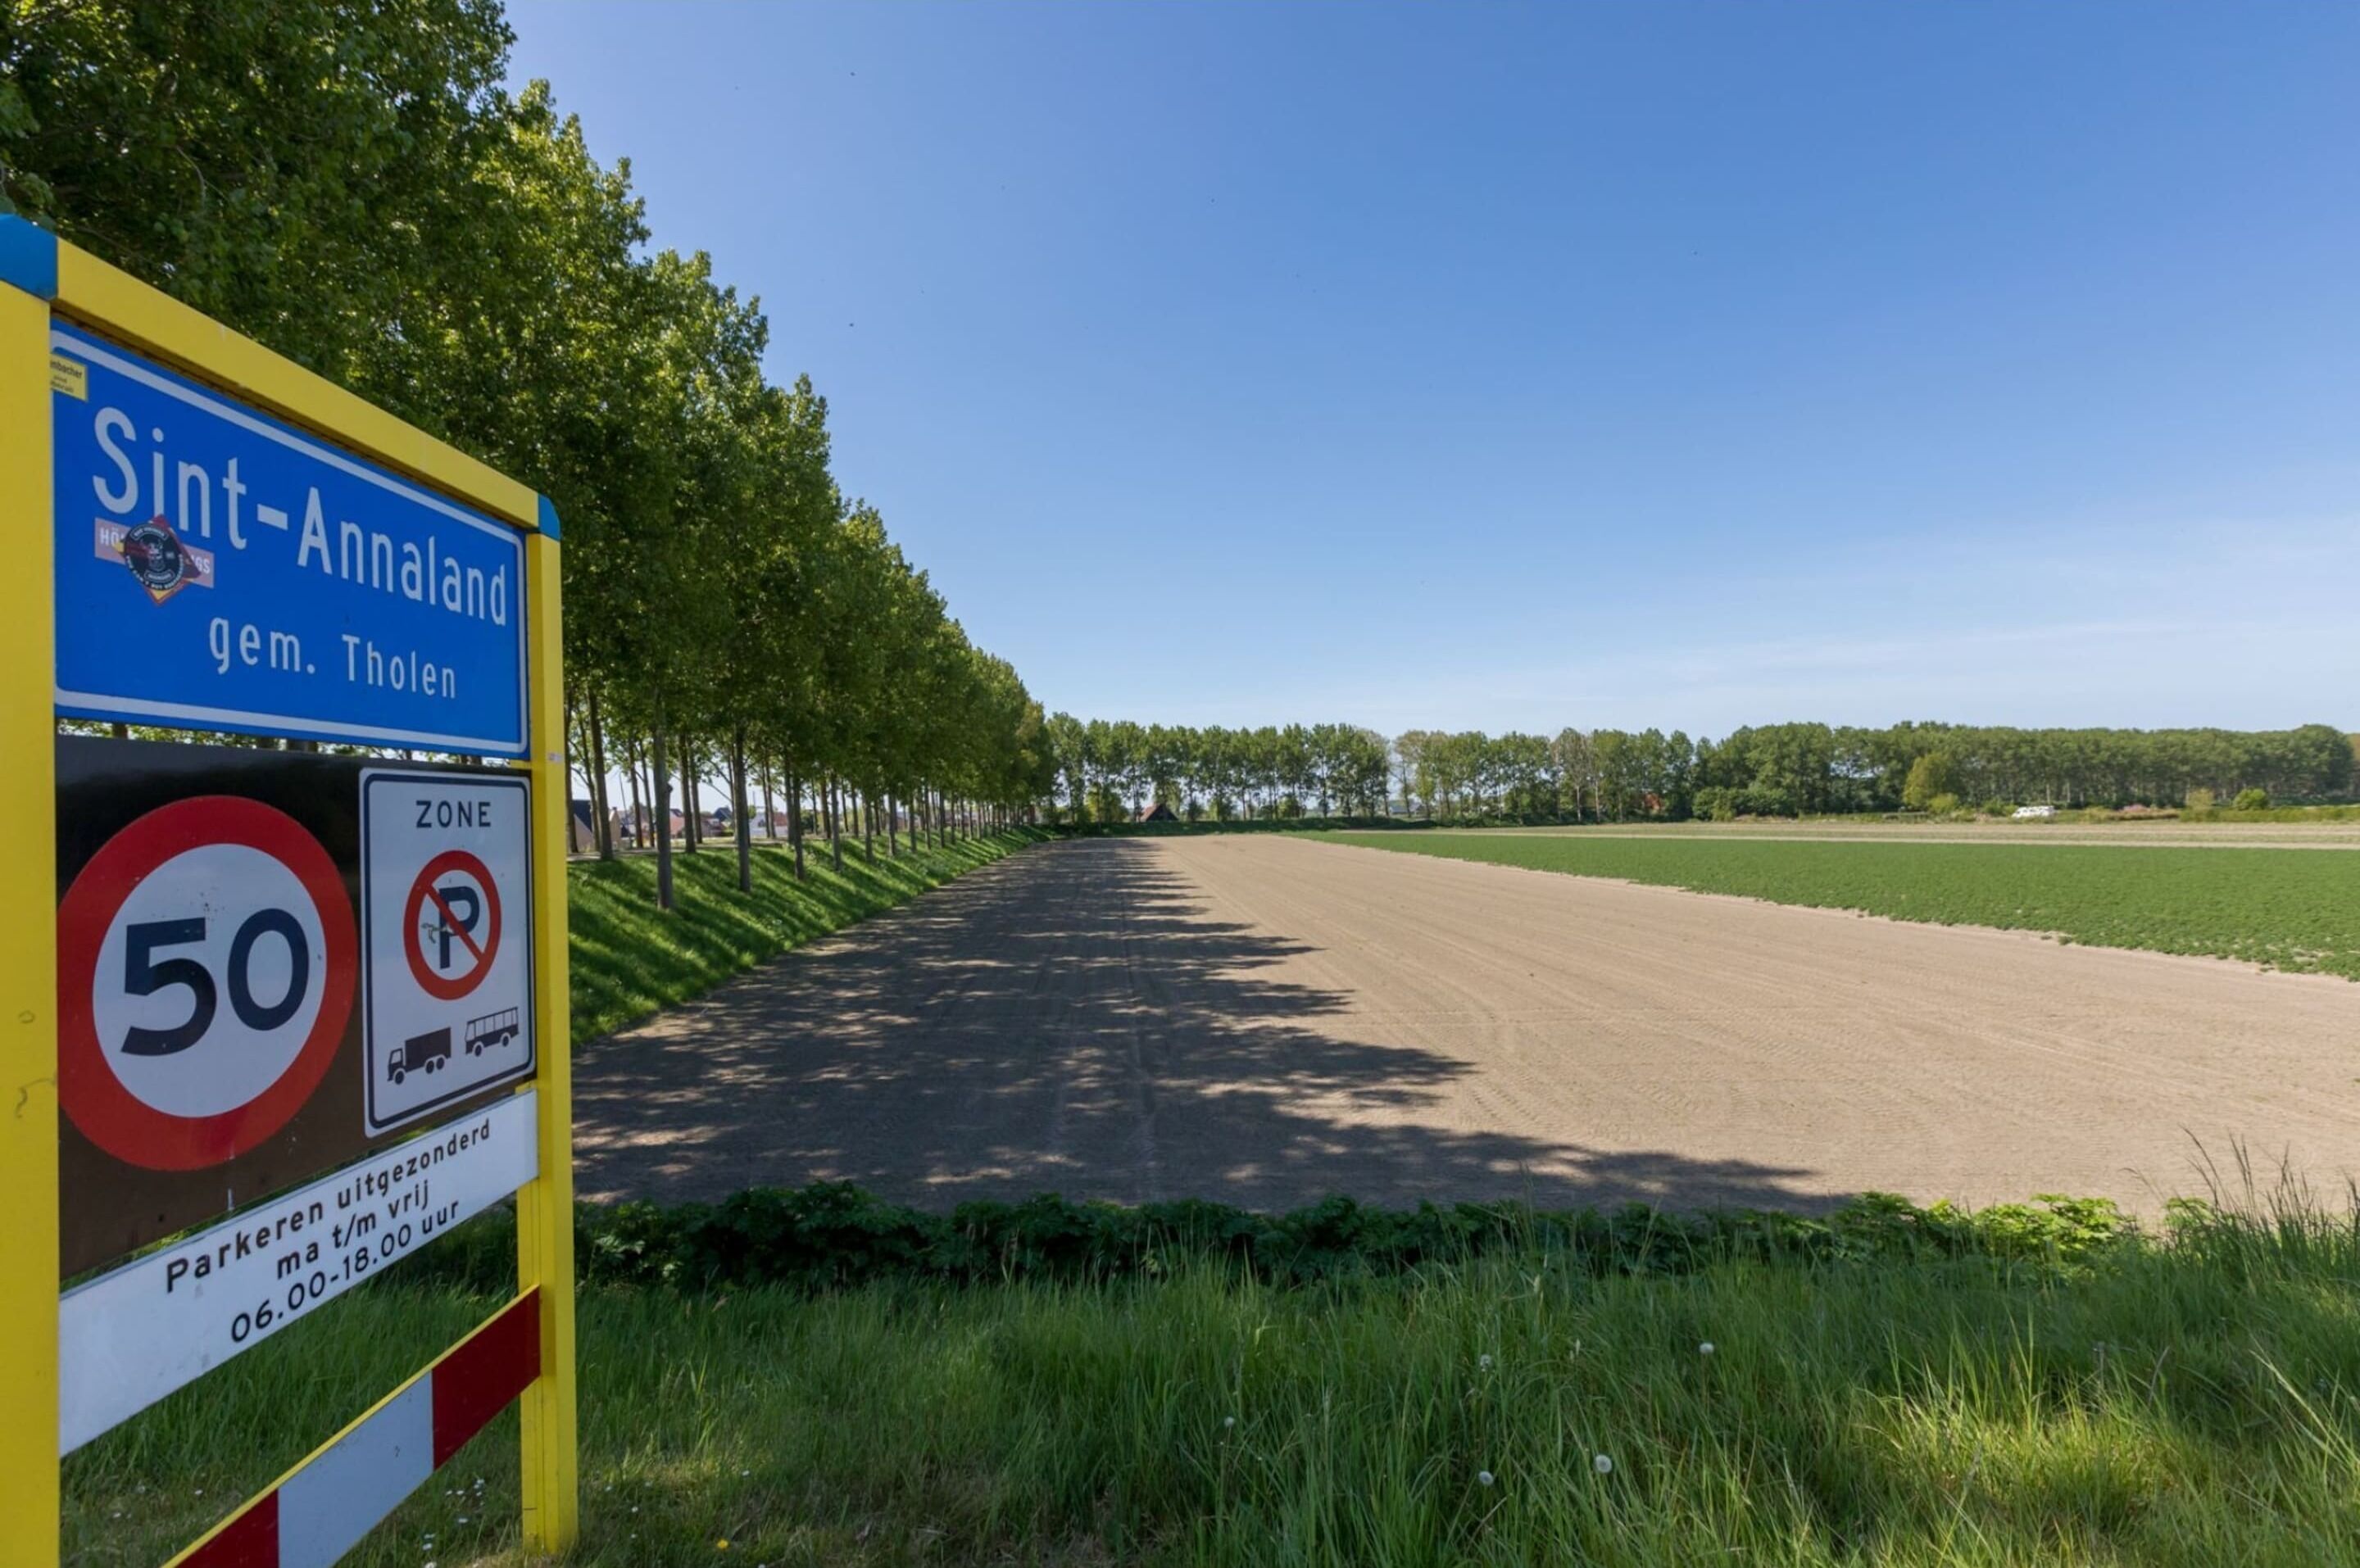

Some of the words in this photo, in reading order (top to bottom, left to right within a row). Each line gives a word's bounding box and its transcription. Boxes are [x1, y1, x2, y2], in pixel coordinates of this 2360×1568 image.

[92, 406, 507, 627] Sint-Annaland
[208, 615, 317, 675] gem.
[341, 634, 456, 699] Tholen
[415, 800, 492, 829] ZONE
[120, 908, 310, 1057] 50
[438, 884, 480, 970] P
[166, 1201, 324, 1294] Parkeren
[337, 1118, 491, 1209] uitgezonderd
[276, 1244, 320, 1280] ma
[331, 1211, 377, 1249] t/m
[388, 1180, 430, 1220] vrij
[230, 1222, 413, 1344] 06.00-18.00
[420, 1199, 461, 1236] uur
